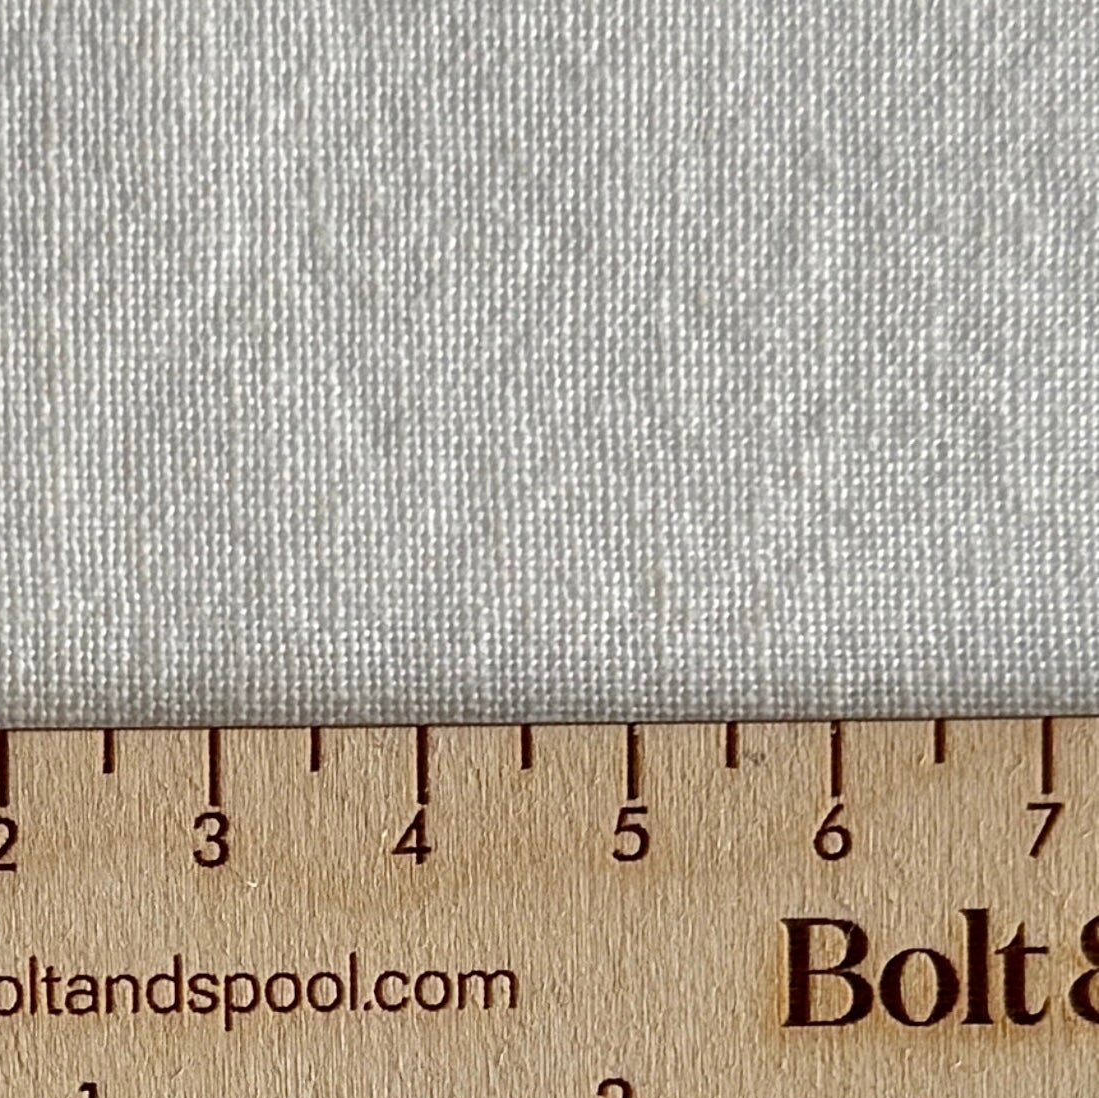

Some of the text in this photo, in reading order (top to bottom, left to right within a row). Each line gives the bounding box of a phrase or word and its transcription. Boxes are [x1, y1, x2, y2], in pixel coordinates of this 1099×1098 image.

[192, 810, 231, 869] 3
[392, 807, 433, 865] 4
[611, 805, 652, 863] 5
[812, 802, 854, 863] 6
[1025, 801, 1066, 859] 7
[779, 907, 1051, 1028] Bolt
